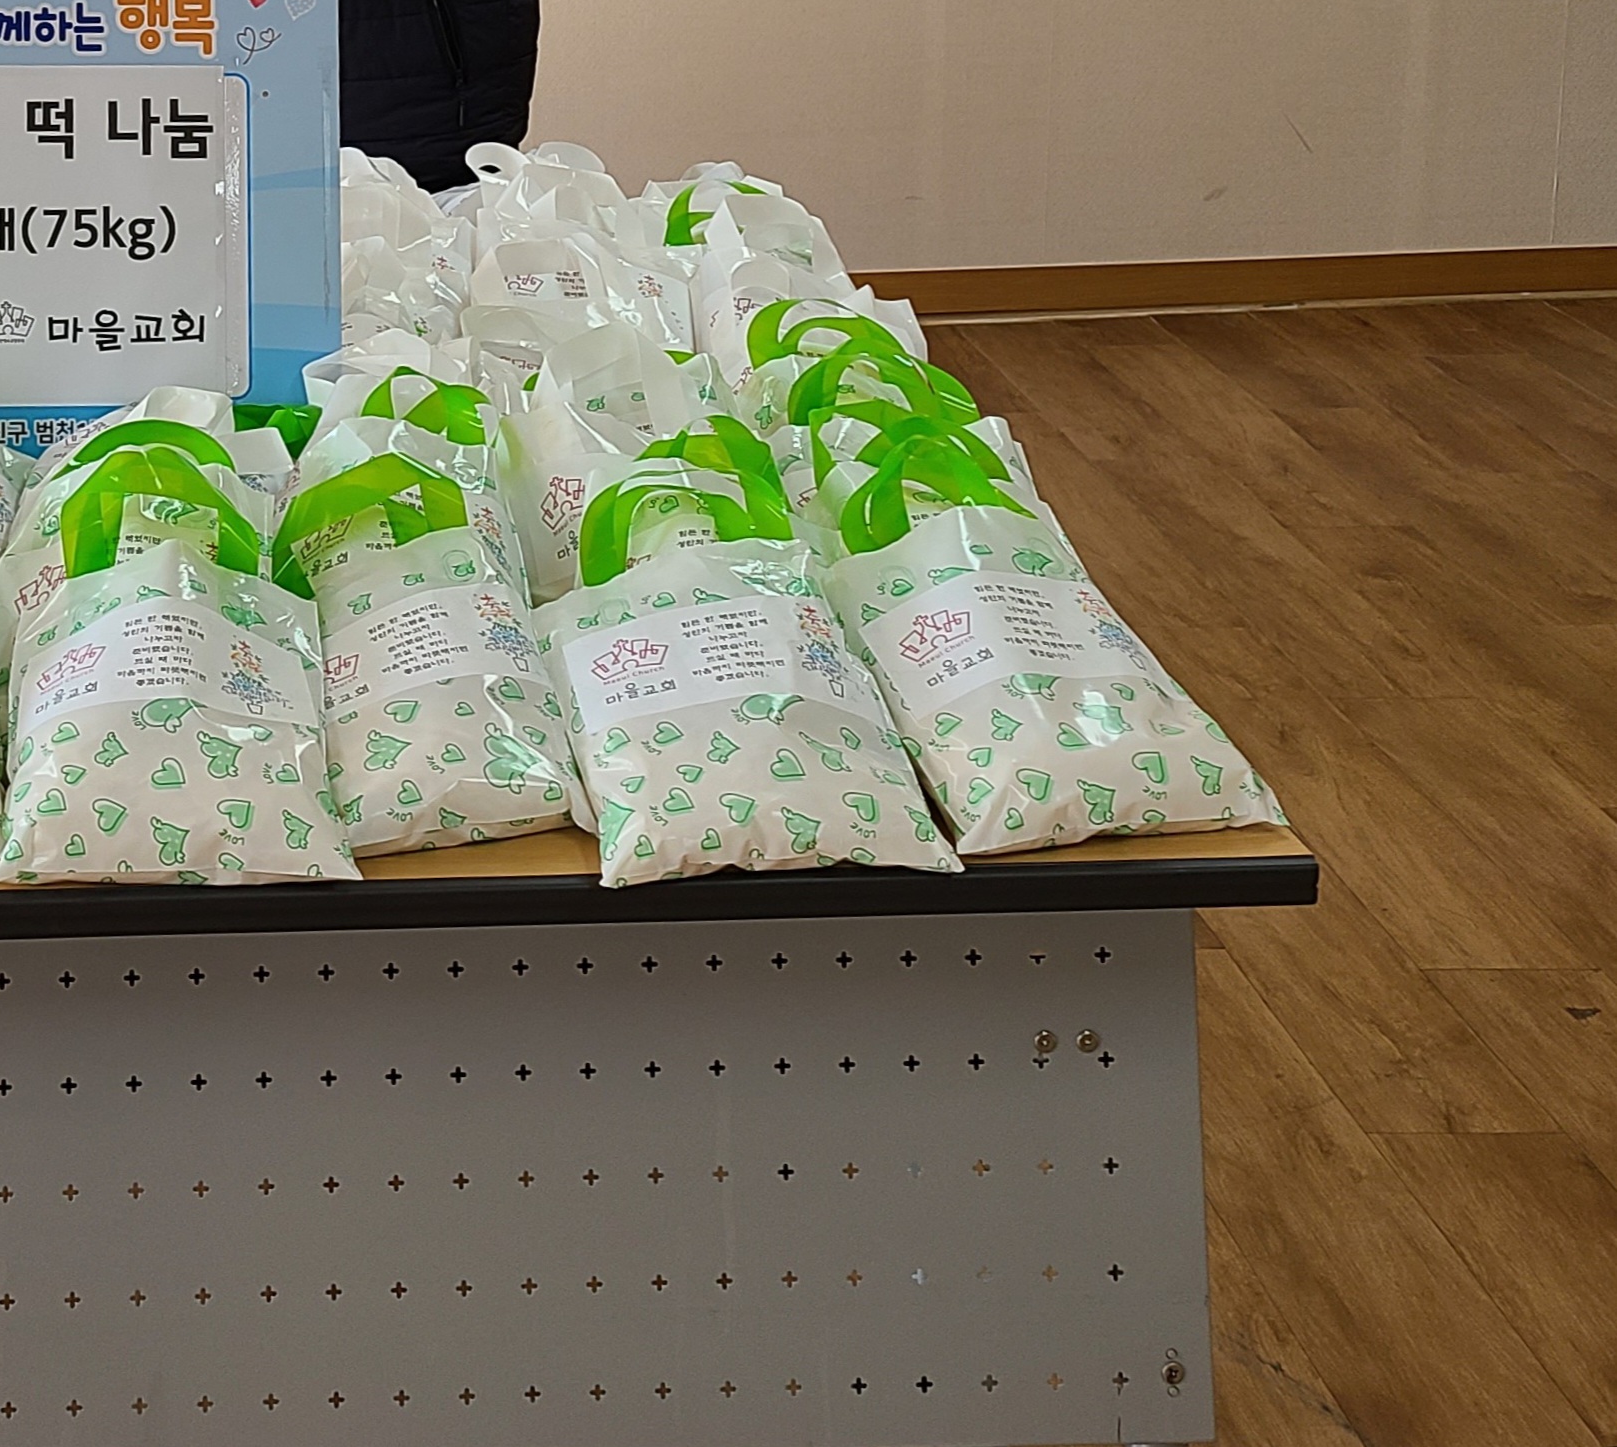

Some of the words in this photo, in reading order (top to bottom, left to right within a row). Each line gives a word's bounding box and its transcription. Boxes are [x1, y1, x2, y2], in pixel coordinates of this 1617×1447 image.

[26, 98, 76, 158] 떡
[107, 98, 216, 159] 나눔
[48, 309, 206, 351] 마을교회
[945, 635, 975, 653] Church
[633, 666, 665, 676] Church
[927, 648, 994, 687] 마을교회
[35, 682, 97, 714] 마을교회
[606, 680, 676, 705] 마을교회
[1001, 683, 1024, 700] LOVE
[731, 707, 749, 724] LOVE
[641, 740, 662, 755] LOVE
[262, 763, 274, 784] LOVE
[426, 755, 446, 774] LOVE
[1142, 786, 1167, 799] LOVE
[386, 808, 413, 821] LOVE
[649, 805, 668, 826] LOVE
[219, 829, 244, 845] LOVE
[850, 822, 876, 838] LOVE
